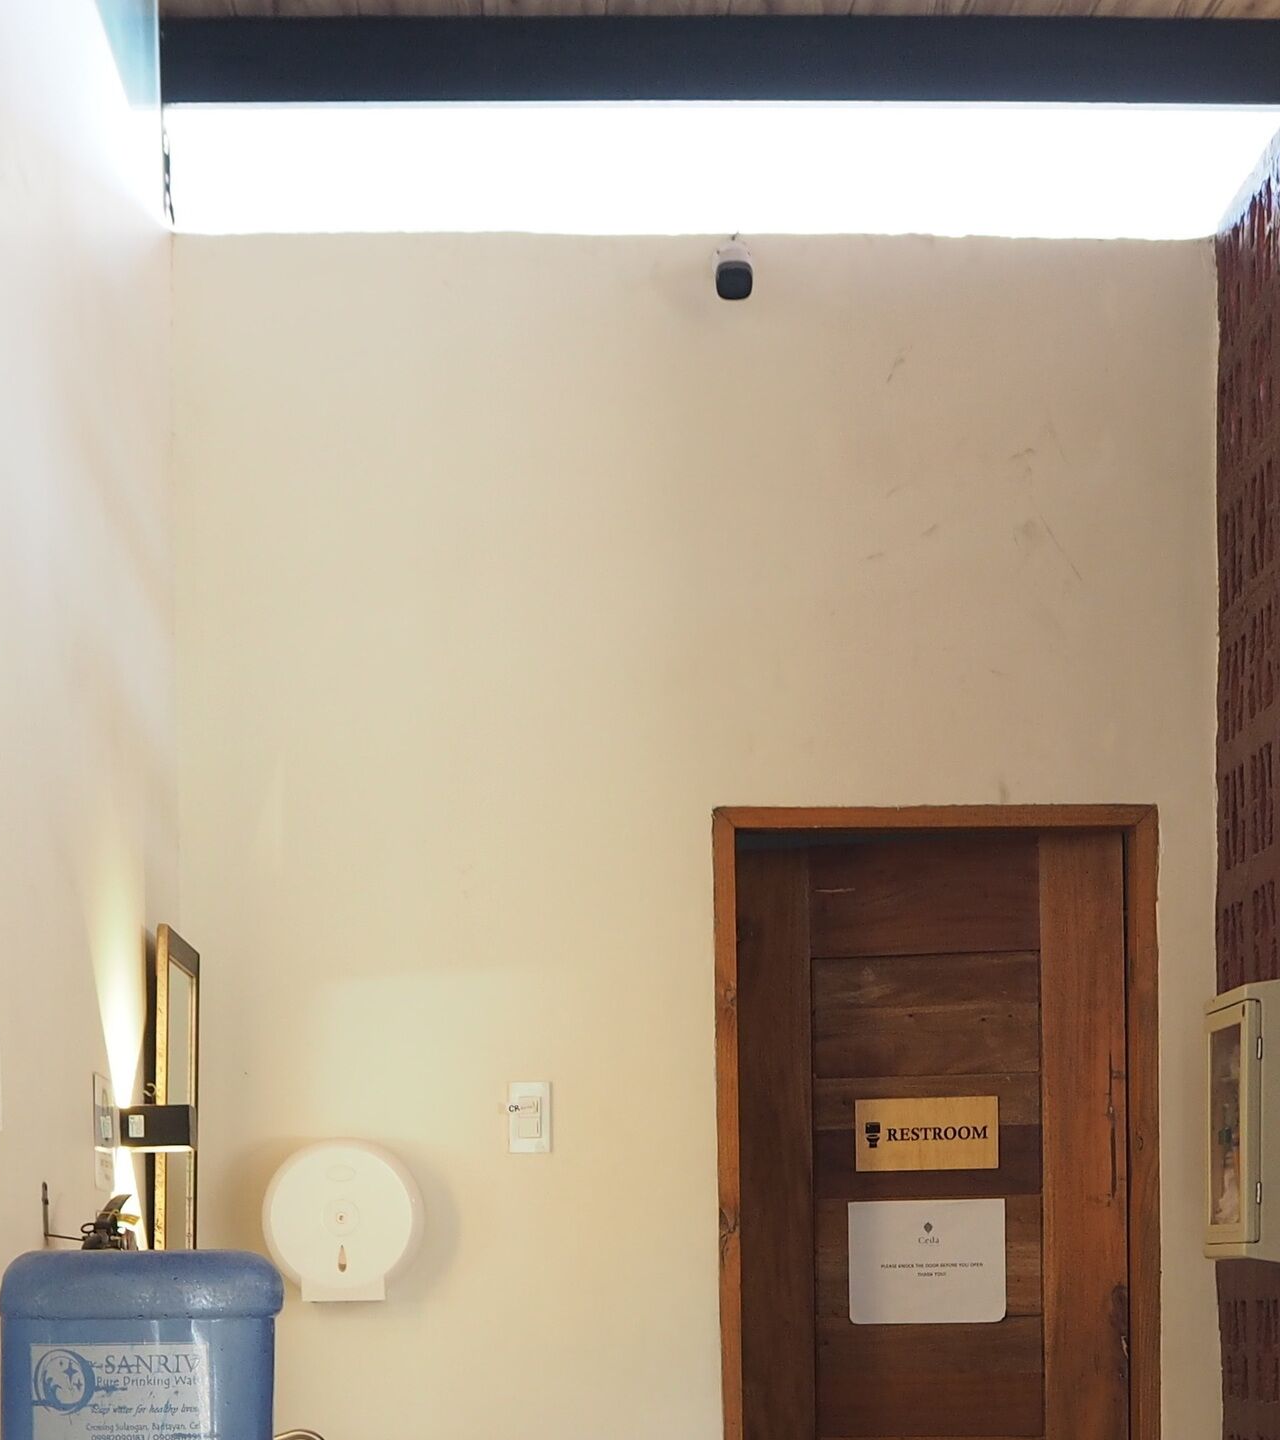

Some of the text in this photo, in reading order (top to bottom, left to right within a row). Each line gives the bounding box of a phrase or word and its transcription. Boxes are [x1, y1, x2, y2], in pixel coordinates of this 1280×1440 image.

[886, 1125, 988, 1141] RESTROOM
[97, 1376, 119, 1385] Pure
[123, 1375, 171, 1388] Drinking
[133, 1404, 146, 1417] for
